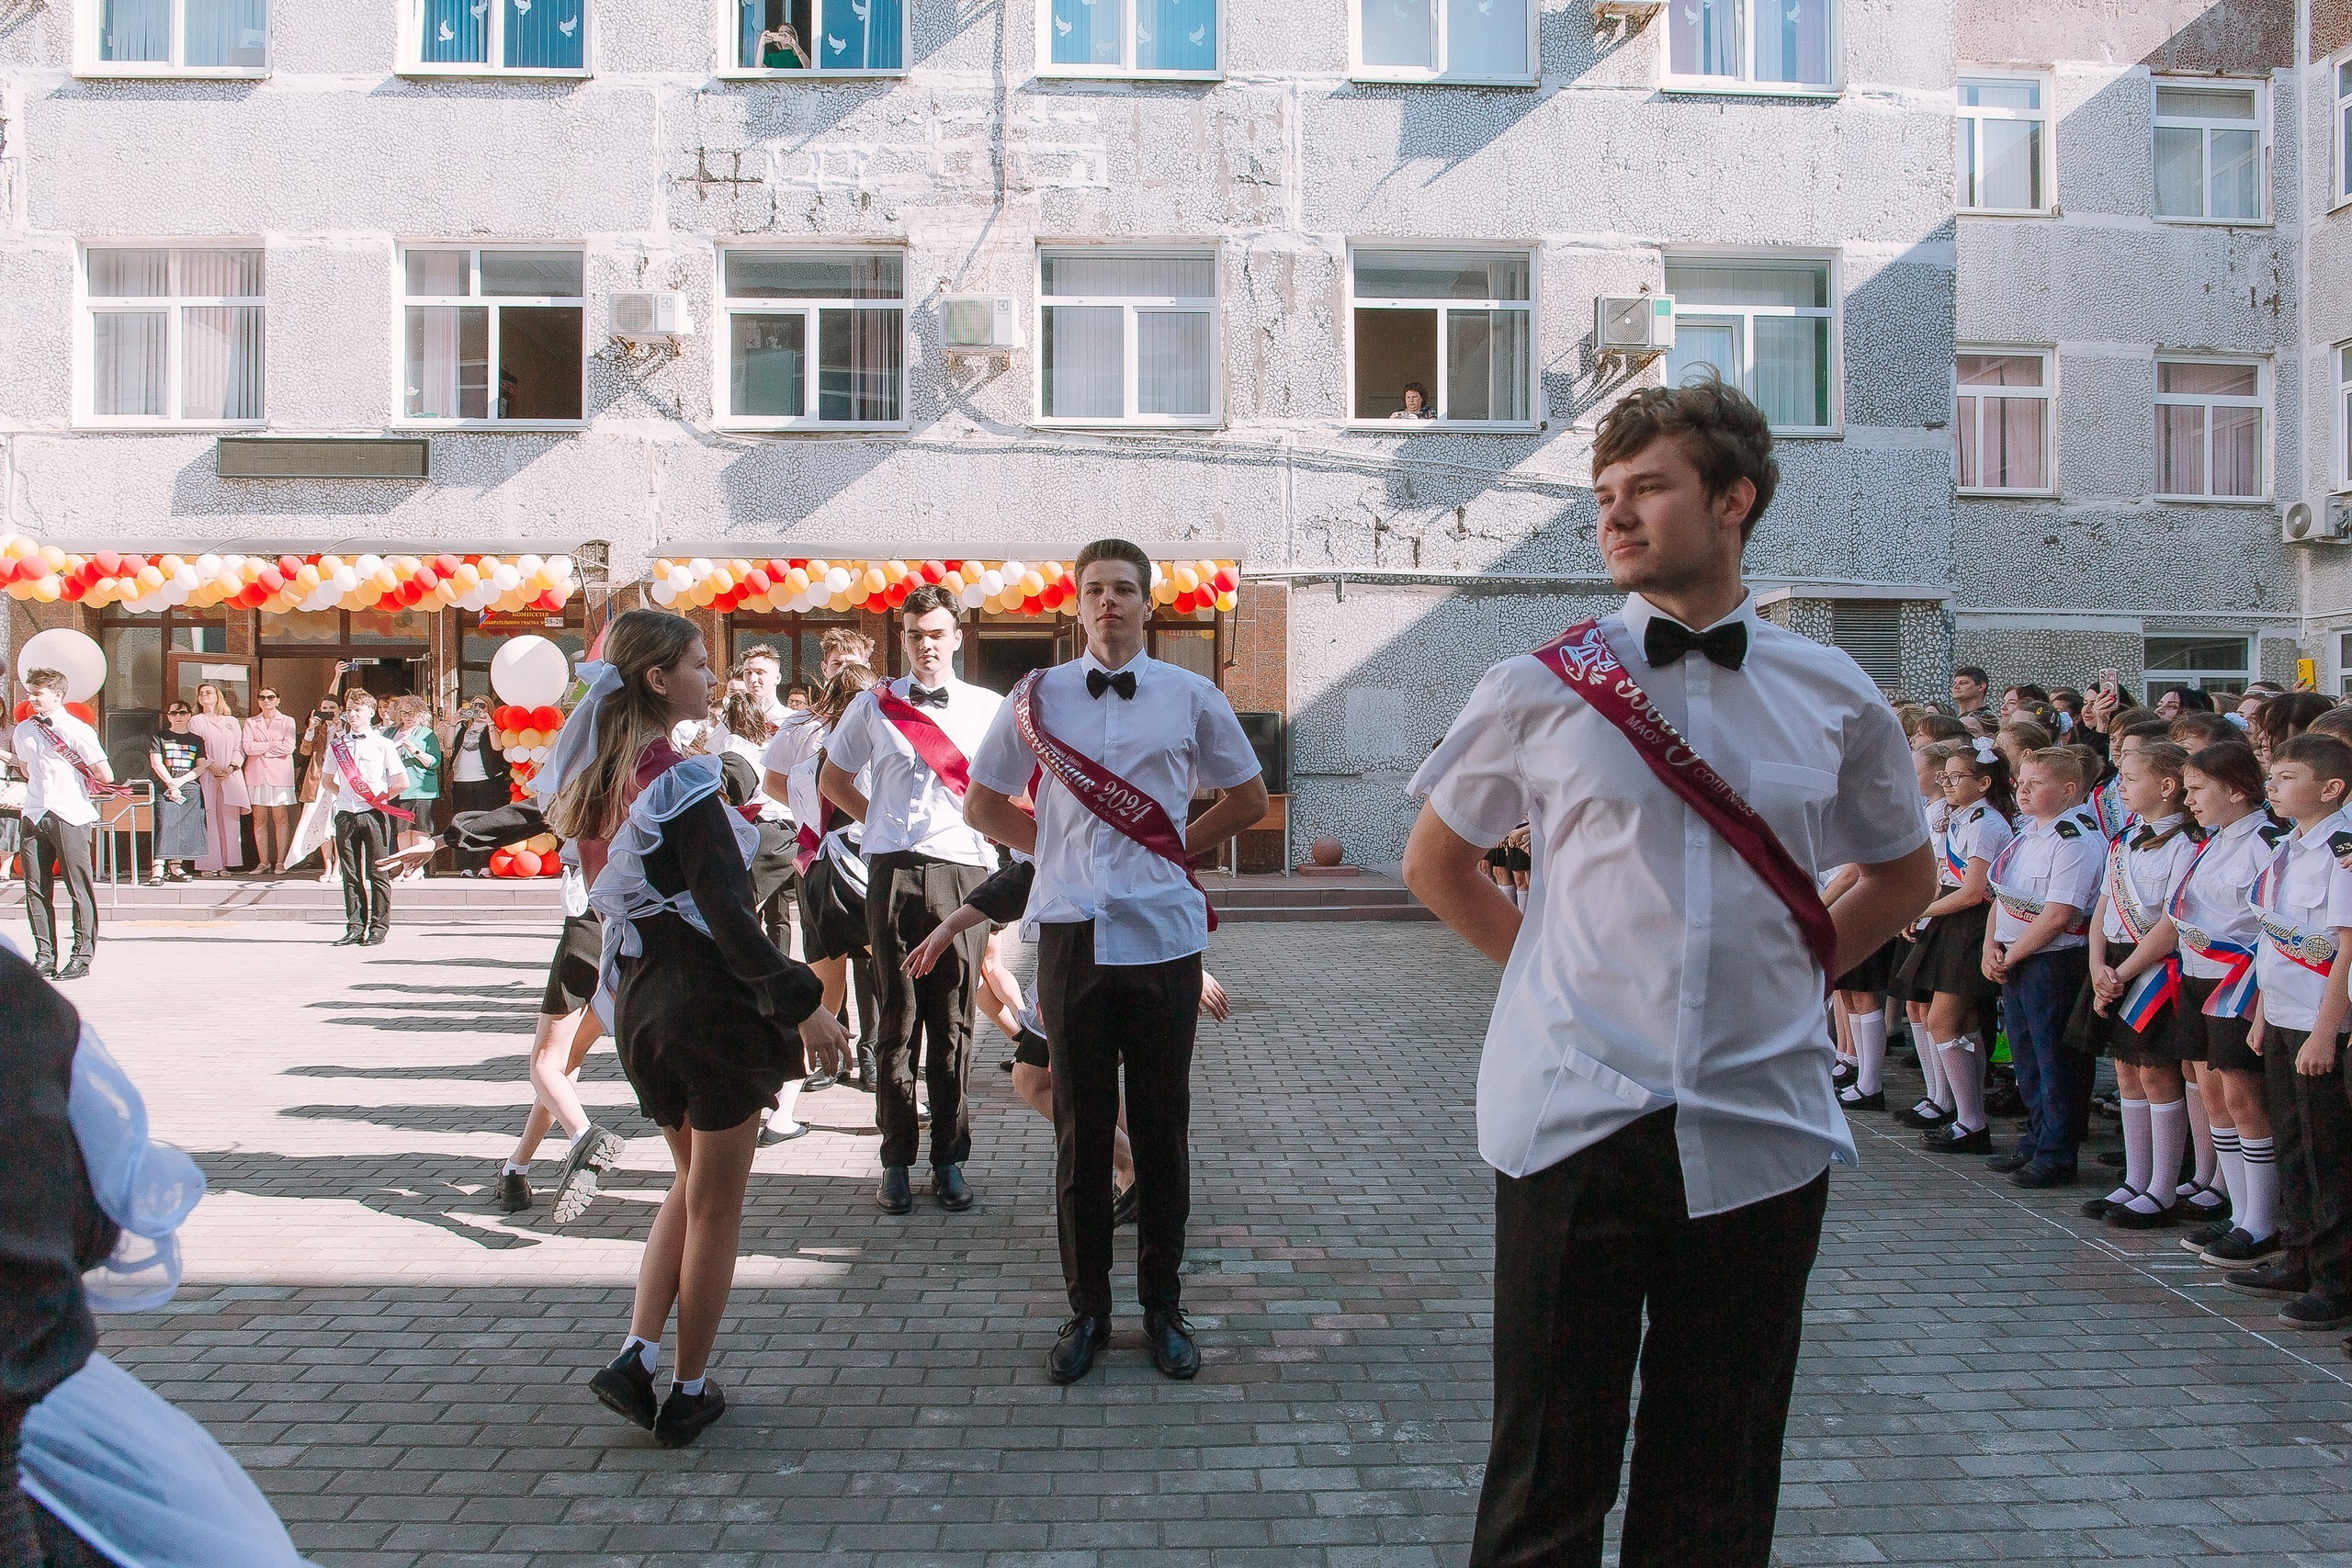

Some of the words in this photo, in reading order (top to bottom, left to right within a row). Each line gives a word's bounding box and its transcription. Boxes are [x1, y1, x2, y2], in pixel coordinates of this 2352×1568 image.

[1015, 698, 1096, 793] Выпускник
[1093, 781, 1153, 823] 2024
[1624, 715, 1667, 745] МАОУ
[1692, 767, 1726, 794] СОШ
[2335, 841, 2352, 853] 33
